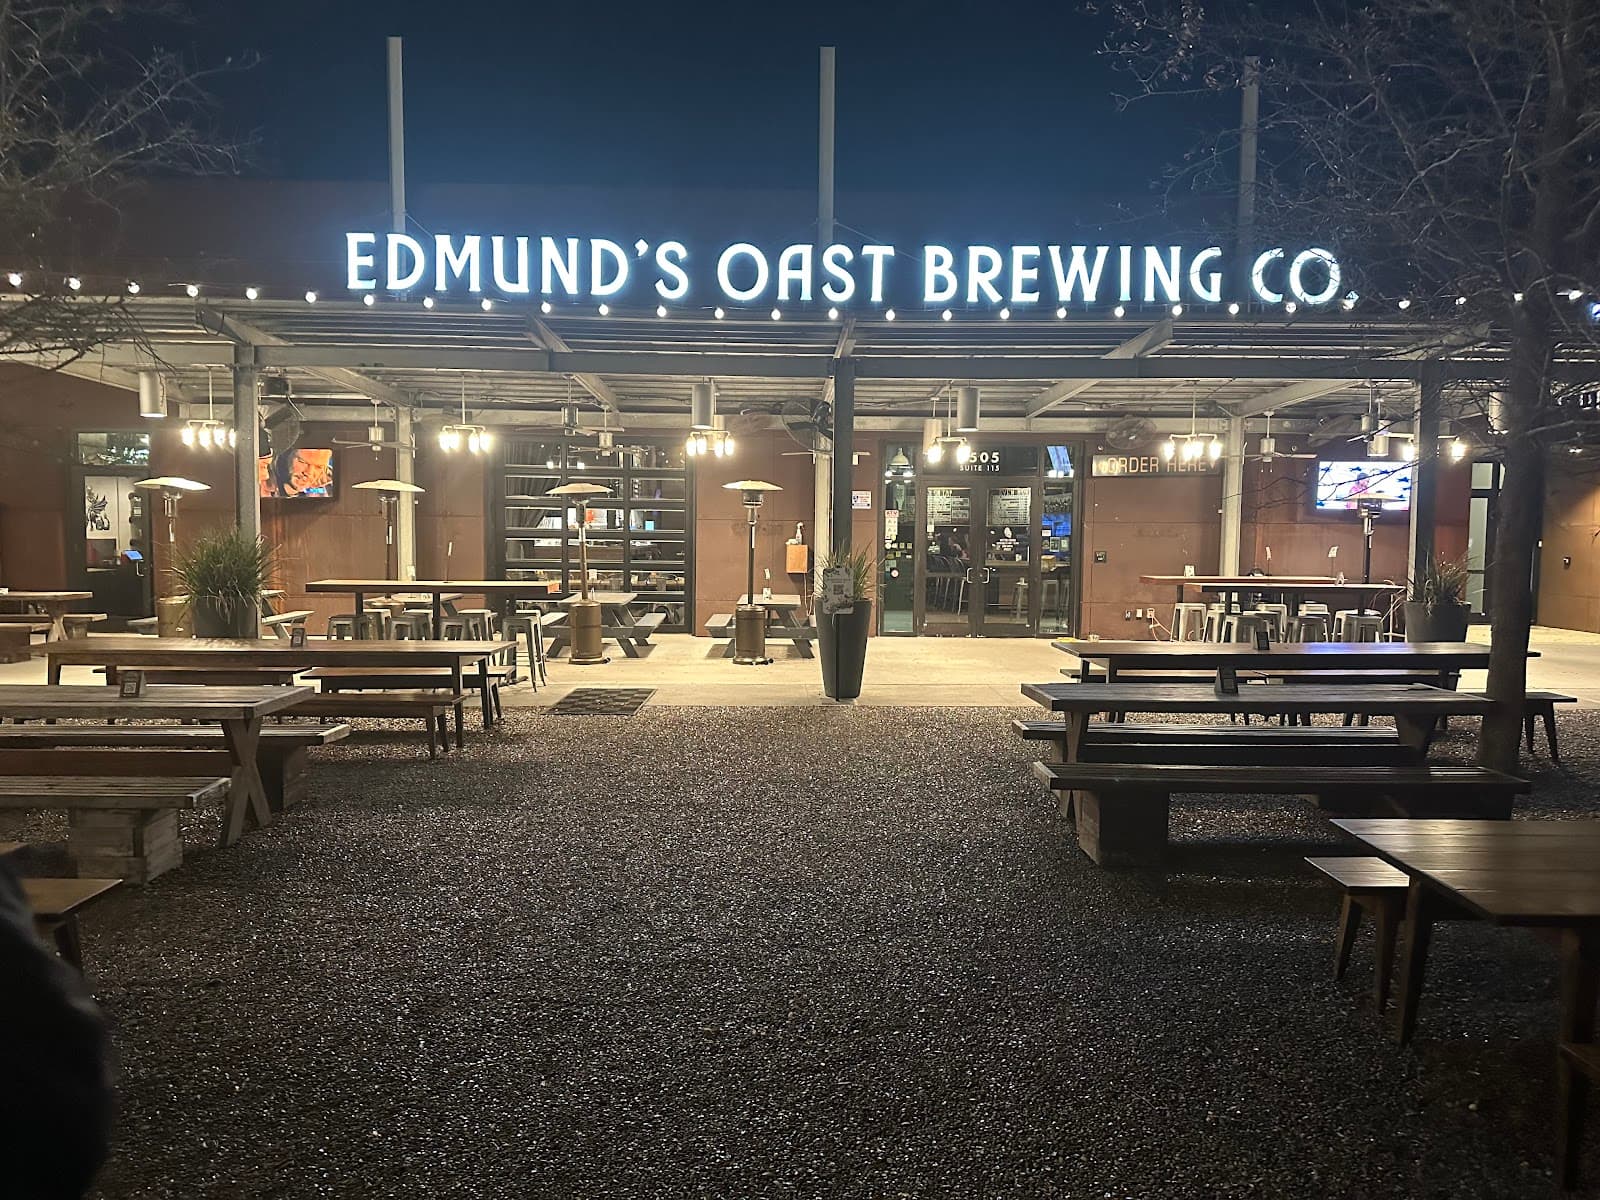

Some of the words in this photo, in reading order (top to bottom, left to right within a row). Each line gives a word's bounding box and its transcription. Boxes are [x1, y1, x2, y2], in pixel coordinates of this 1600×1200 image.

[346, 232, 689, 300] EDMUND'S
[717, 242, 895, 302] OAST
[923, 245, 1222, 303] BREWING
[1251, 247, 1359, 305] CO.
[959, 464, 982, 472] SUITE
[986, 464, 1000, 472] 115
[1107, 456, 1159, 473] ORDER
